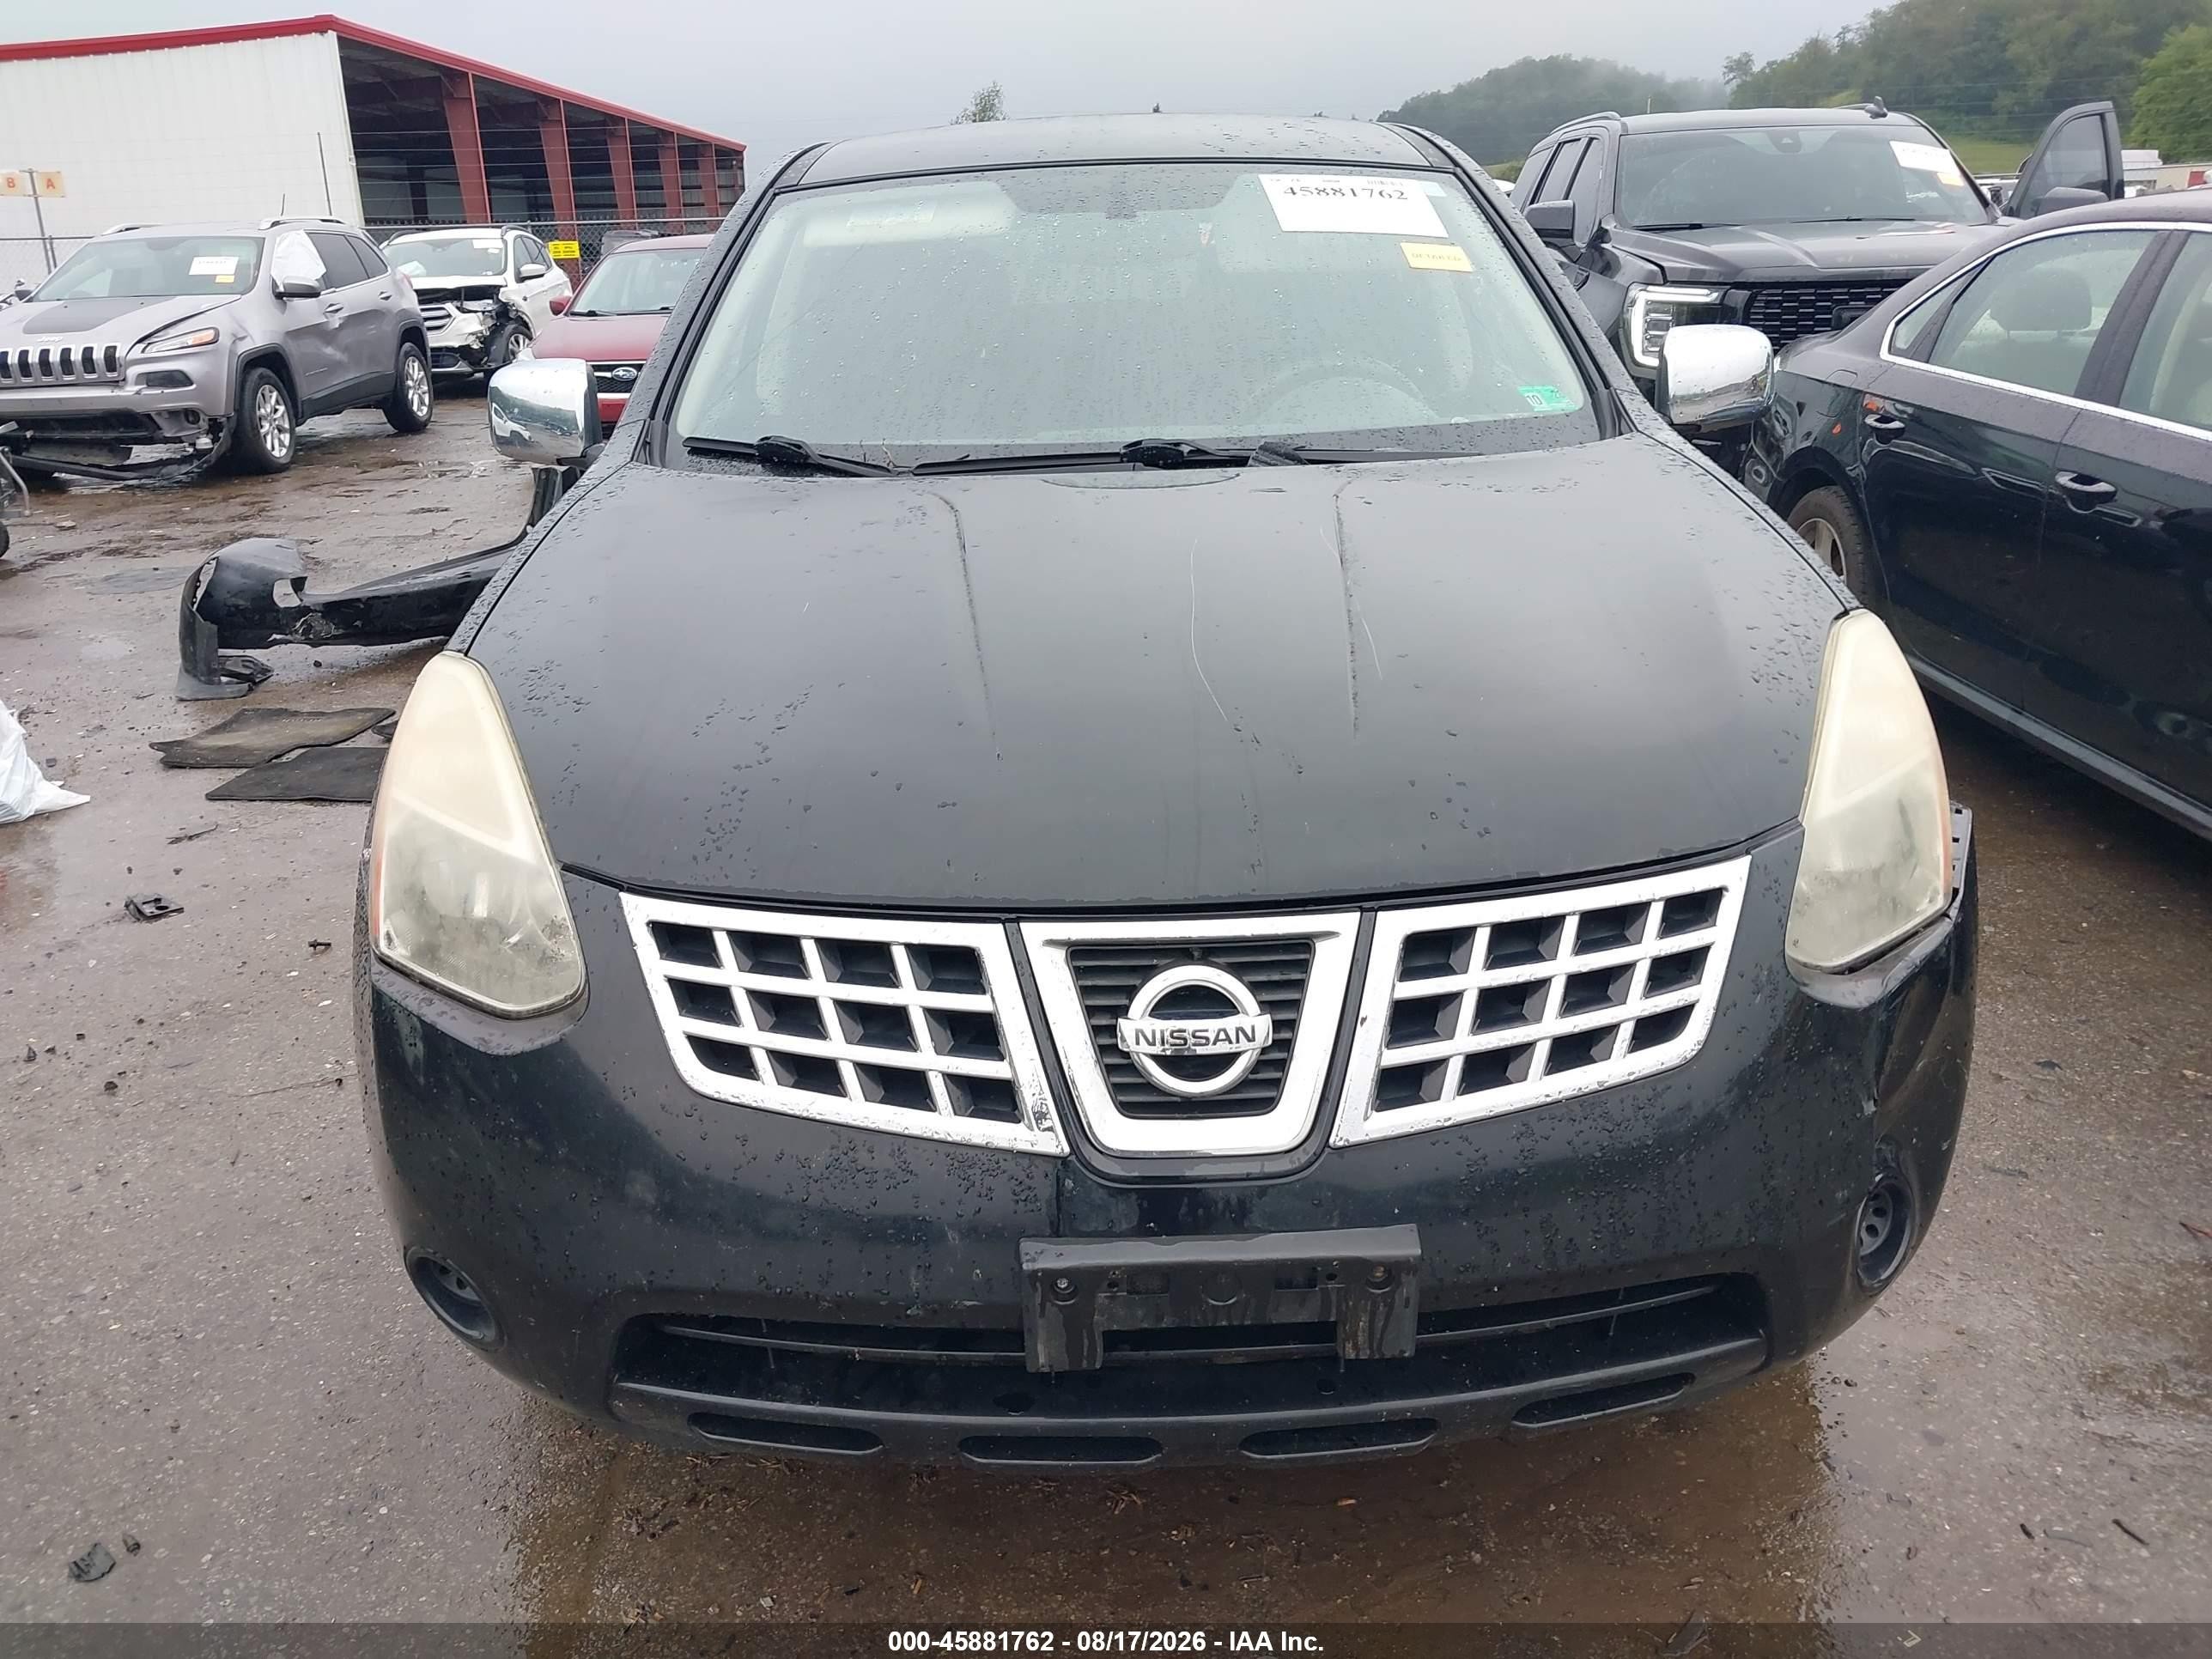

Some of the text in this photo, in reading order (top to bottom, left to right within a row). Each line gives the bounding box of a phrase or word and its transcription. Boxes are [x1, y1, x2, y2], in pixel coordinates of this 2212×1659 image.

[7, 177, 15, 188] B
[46, 178, 56, 190] A
[1284, 185, 1408, 200] 45881762
[1134, 1024, 1256, 1047] NISSAN
